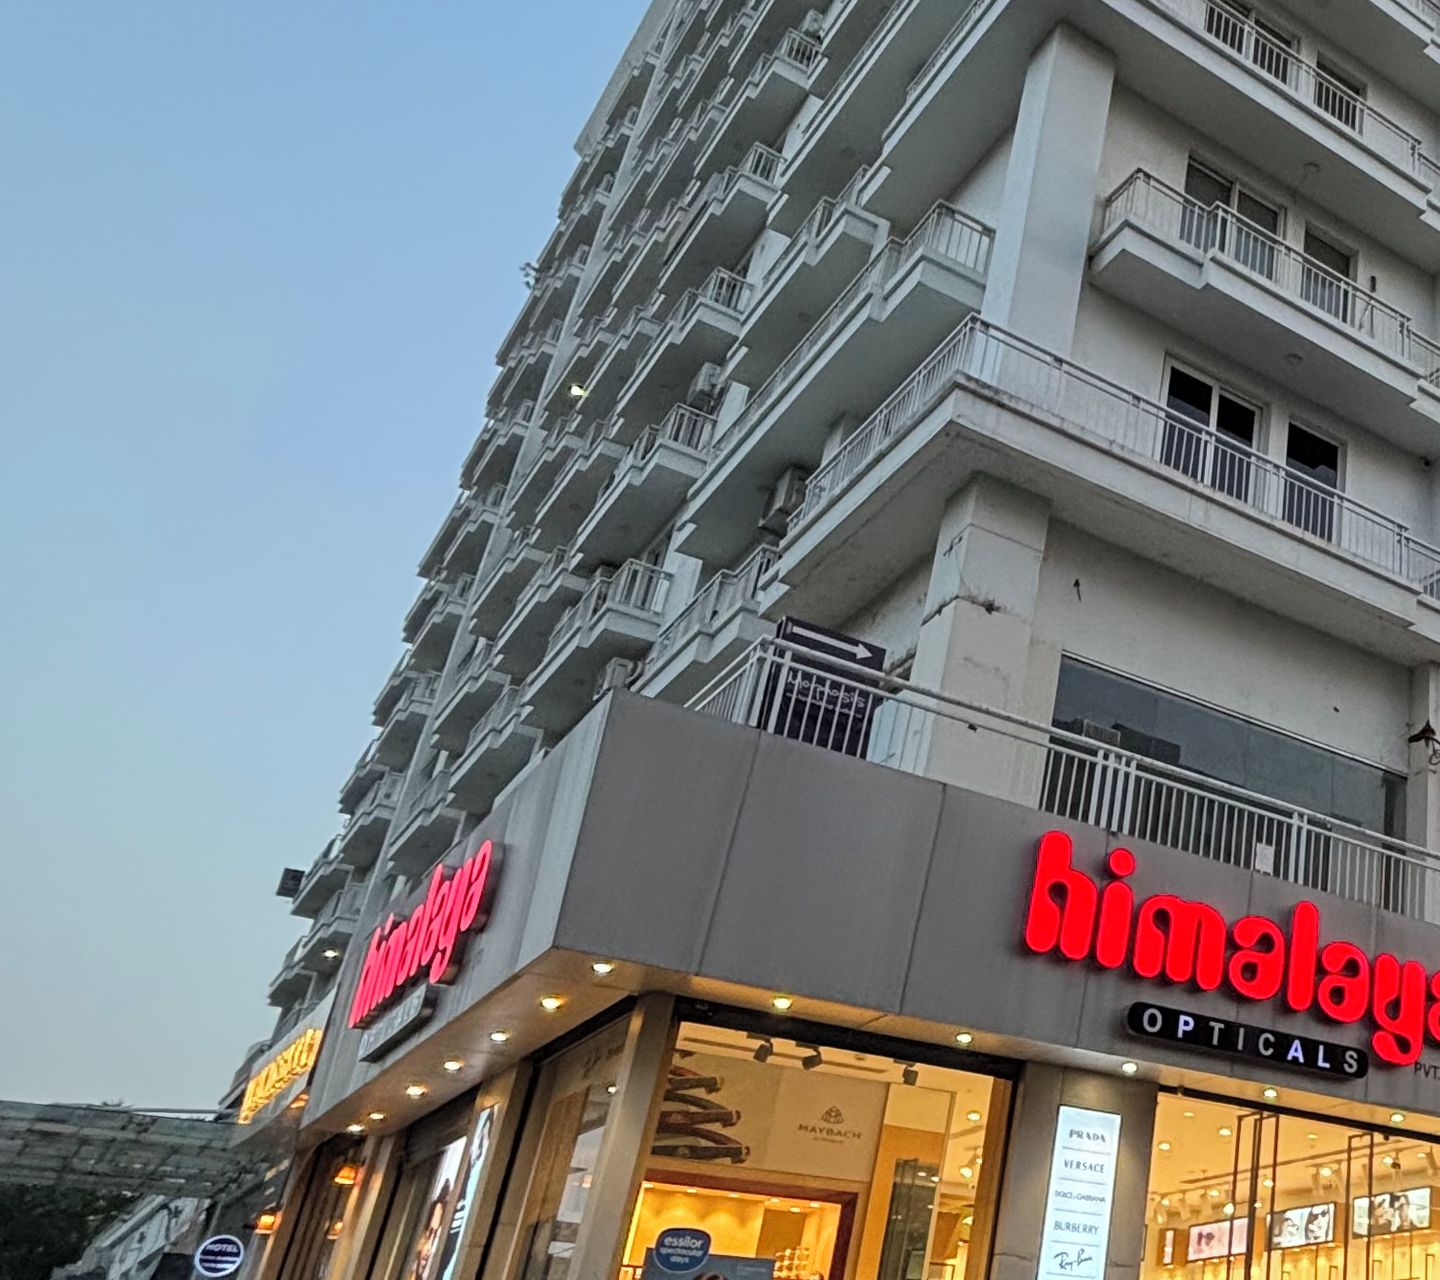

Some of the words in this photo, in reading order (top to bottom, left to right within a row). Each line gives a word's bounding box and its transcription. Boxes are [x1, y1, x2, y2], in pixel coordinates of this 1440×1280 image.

[348, 839, 492, 1029] himalaya
[1142, 1007, 1359, 1074] OPTICALS
[1414, 1061, 1440, 1082] PVT.
[798, 1123, 862, 1140] MAYBACH
[1068, 1128, 1107, 1144] PRADA
[1063, 1159, 1105, 1174] VERSACE
[1053, 1220, 1100, 1236] BURBERRY
[663, 1235, 705, 1249] essilor
[1053, 1247, 1093, 1271] Ray-Ban
